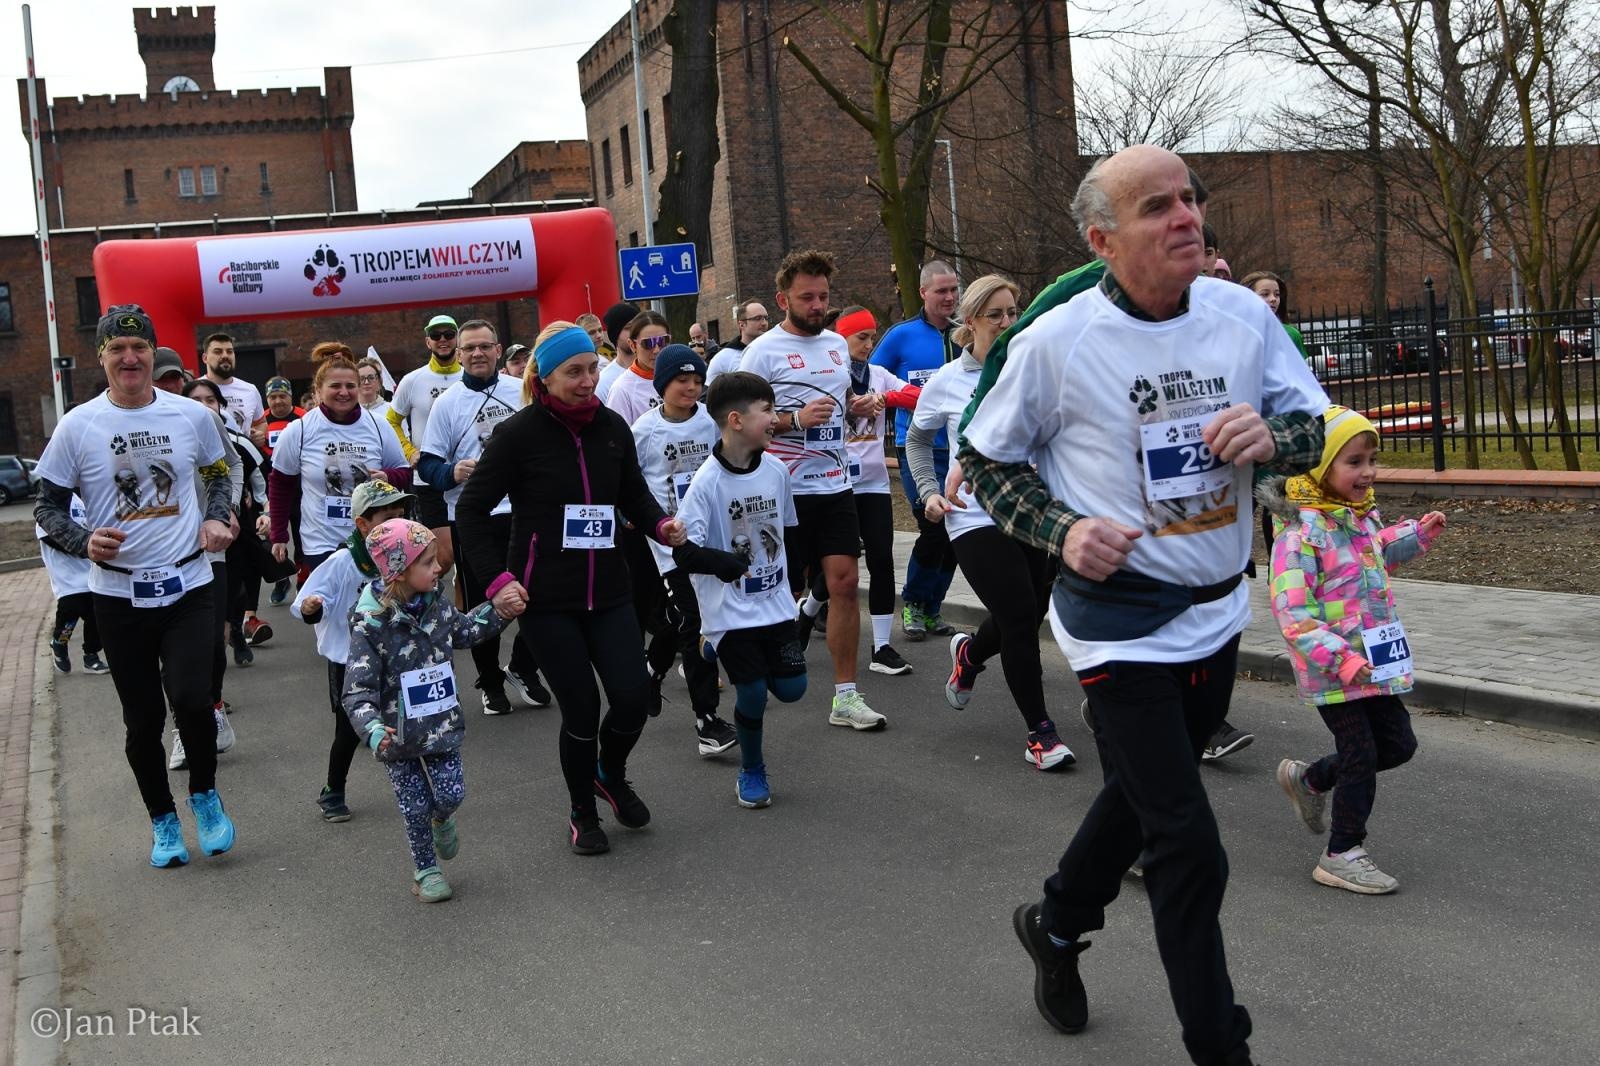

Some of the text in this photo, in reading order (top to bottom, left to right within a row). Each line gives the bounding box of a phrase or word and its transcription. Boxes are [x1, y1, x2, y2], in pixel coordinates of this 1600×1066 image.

[351, 240, 522, 273] TROPEMWILCZYM
[230, 259, 280, 272] Raciborskie
[390, 274, 421, 283] PAMIĘCI
[422, 270, 464, 280] ŻOŁNIERZY
[465, 266, 509, 276] WYKLĘTYCH
[232, 283, 263, 294] Kultury
[1158, 370, 1193, 384] TROPEM
[1162, 377, 1227, 401] WILCZYM
[1168, 409, 1183, 419] XIV
[1182, 404, 1214, 418] EDYCJA
[130, 435, 171, 448] WILCZYM
[819, 428, 834, 441] 80
[1183, 429, 1202, 439] WILC
[679, 443, 709, 455] WILCZYM
[1179, 443, 1215, 474] 29
[744, 495, 763, 503] TROPEM
[745, 498, 777, 513] WILCZYM
[583, 520, 603, 537] 43
[154, 581, 165, 596] 5
[761, 574, 777, 590] 54
[1389, 640, 1406, 660] 44
[427, 681, 446, 700] 45
